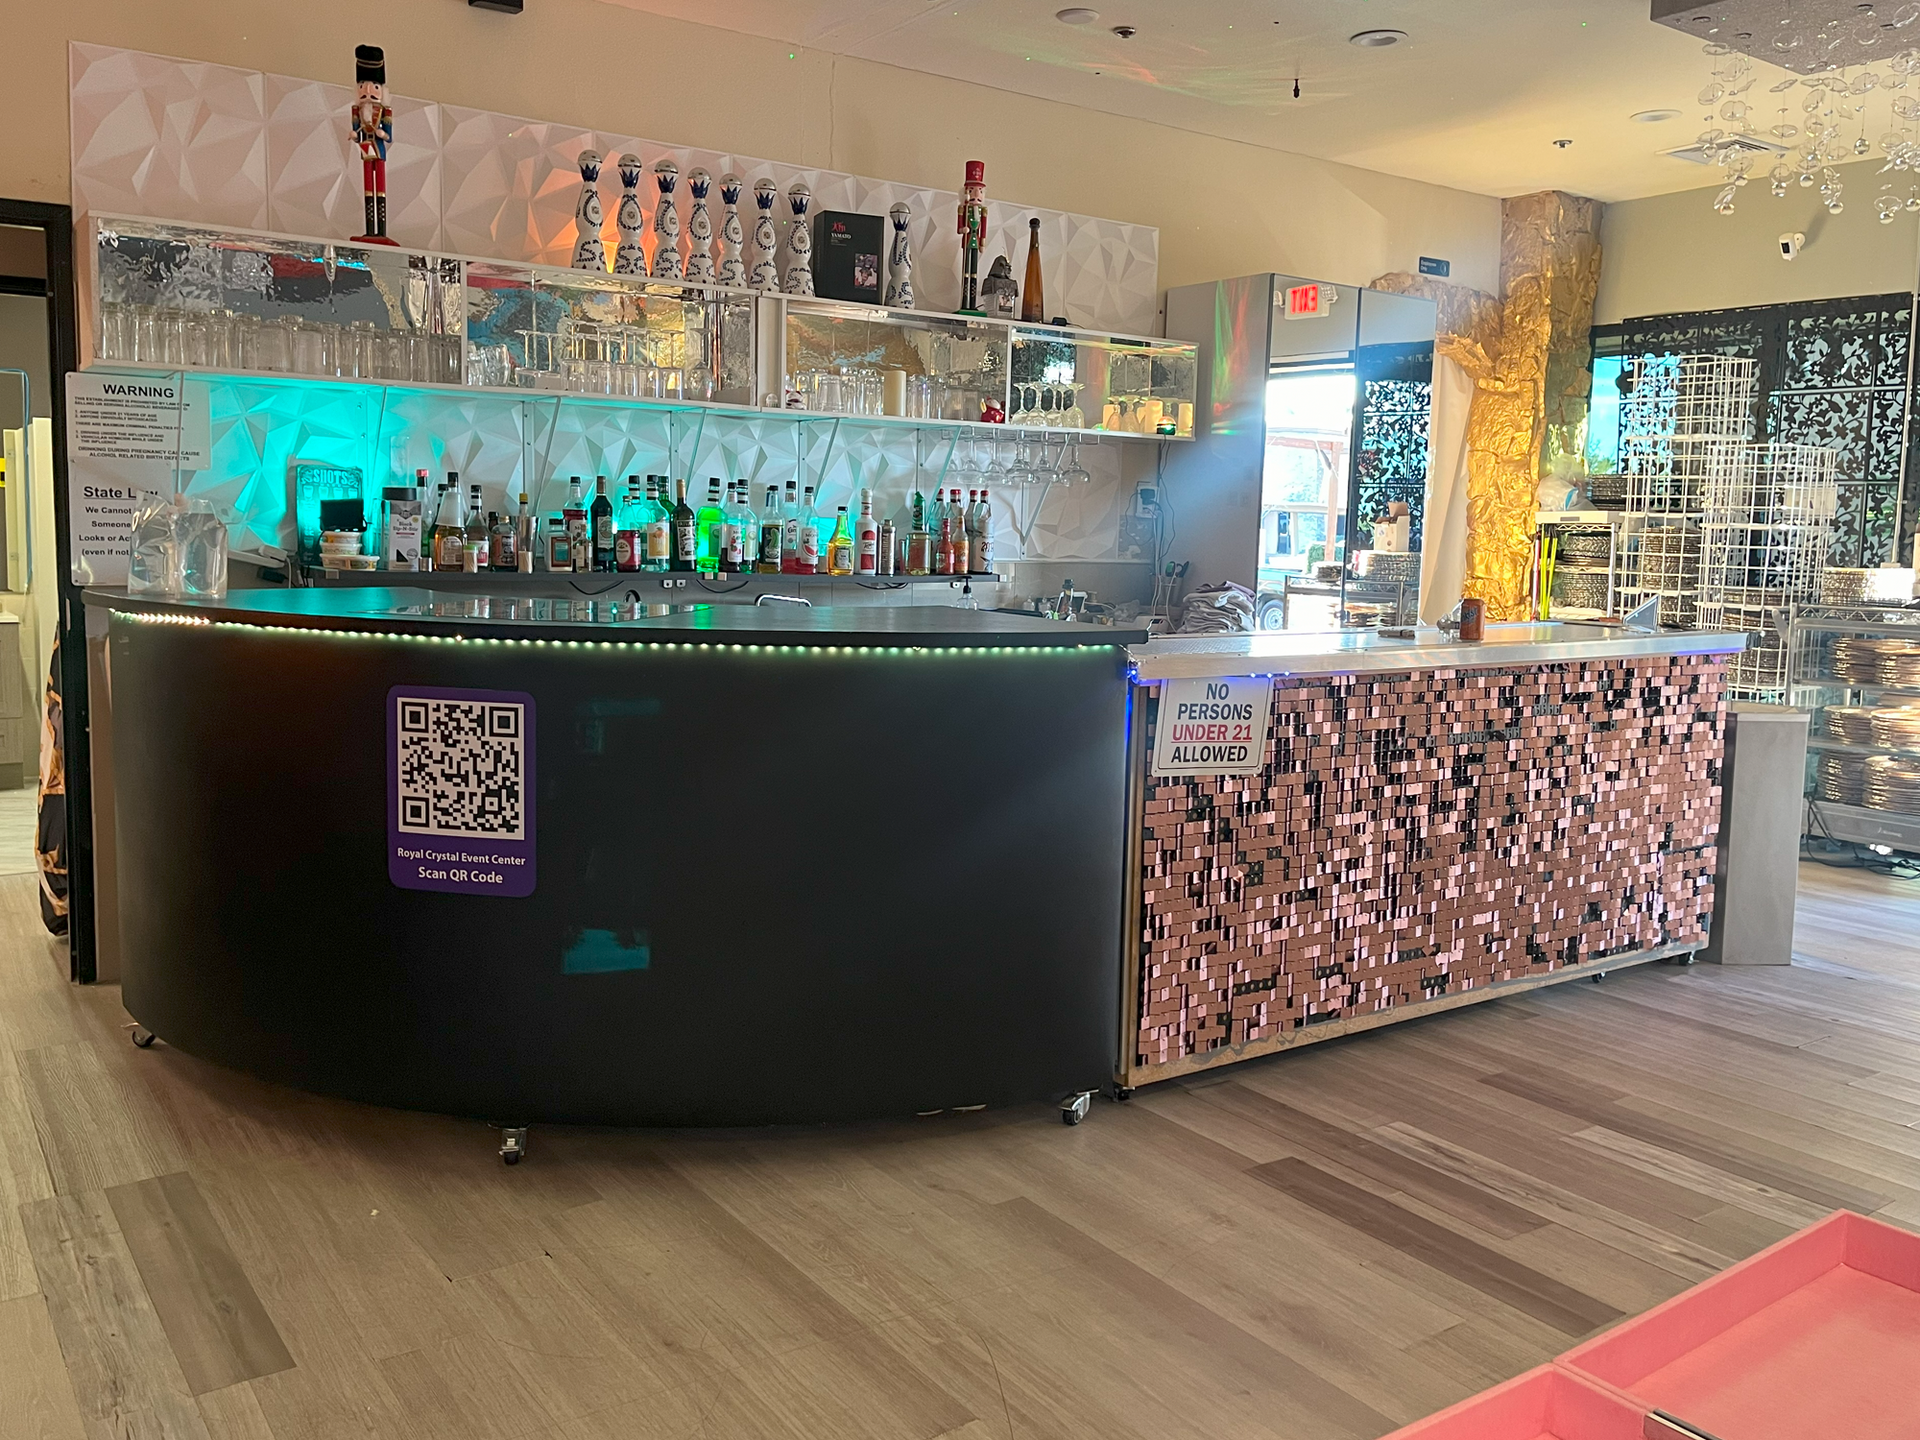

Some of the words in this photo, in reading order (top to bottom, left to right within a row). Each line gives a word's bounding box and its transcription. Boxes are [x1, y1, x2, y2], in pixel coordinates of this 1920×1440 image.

[103, 384, 174, 398] WARNING
[313, 469, 348, 485] SHOTS
[84, 486, 123, 498] State
[85, 506, 99, 514] We
[78, 534, 105, 542] Looks
[81, 548, 106, 556] (even
[1206, 683, 1229, 700] NO
[1177, 703, 1253, 720] PERSONS
[1172, 724, 1228, 741] UNDER
[1232, 724, 1252, 740] 21
[1171, 745, 1248, 763] ALLOWED
[397, 847, 424, 860] Royal
[425, 850, 459, 862] Crystal
[461, 853, 490, 863] Event
[491, 854, 526, 865] Center
[418, 866, 447, 880] Scan
[449, 869, 468, 882] QR
[470, 870, 503, 884] Code
